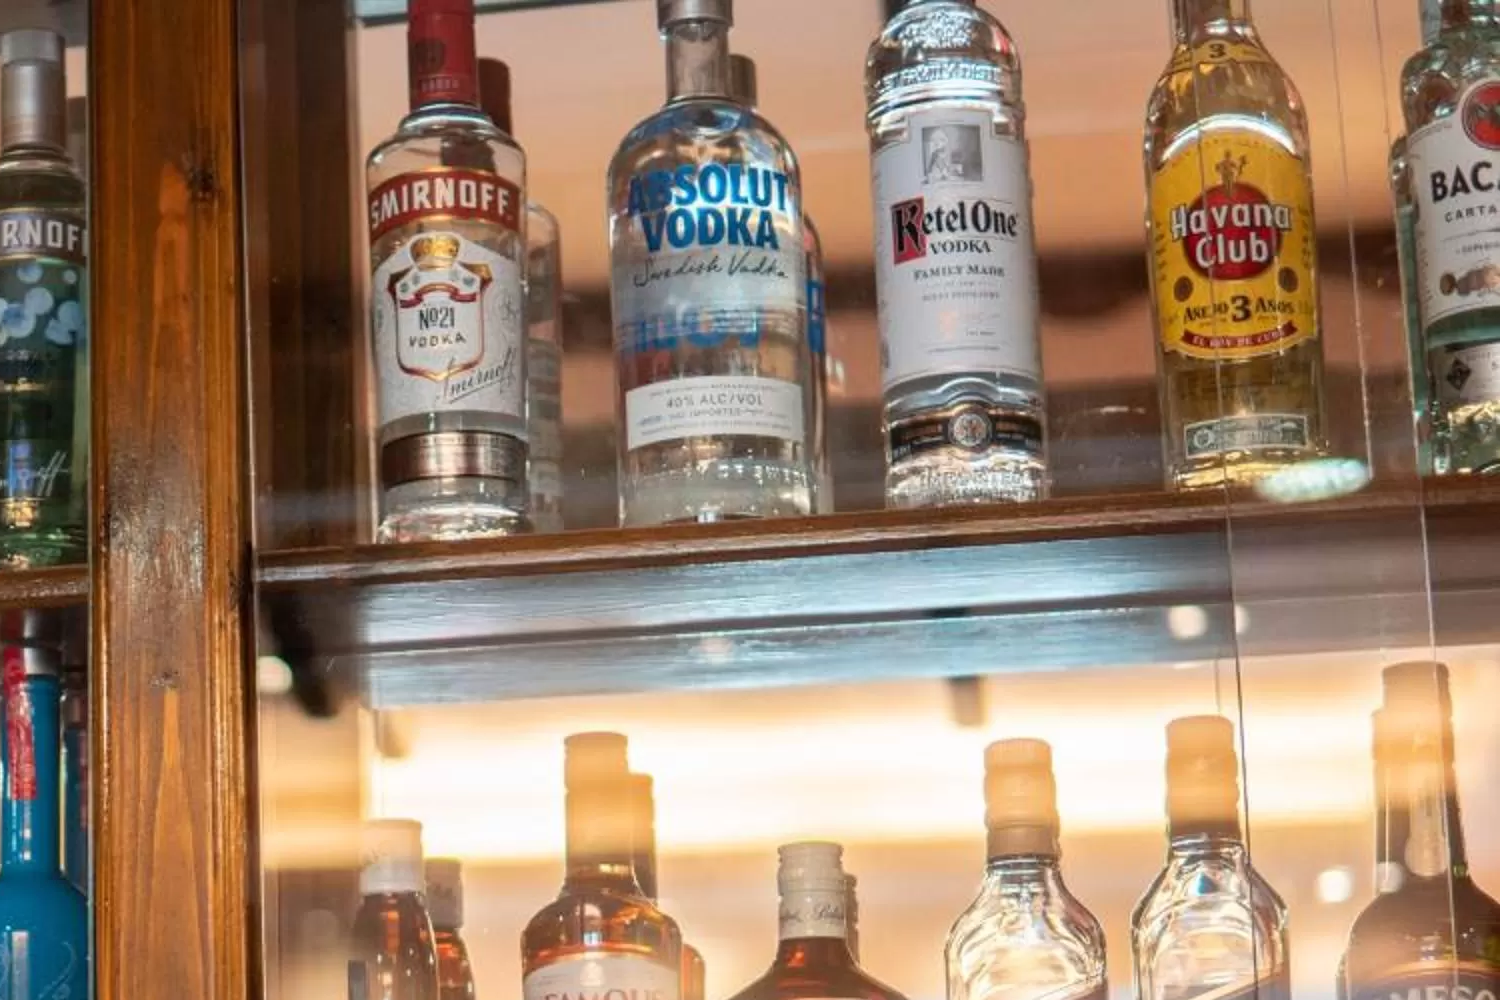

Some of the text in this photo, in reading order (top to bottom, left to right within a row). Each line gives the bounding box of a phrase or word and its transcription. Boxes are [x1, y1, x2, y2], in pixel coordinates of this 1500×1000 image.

[629, 163, 790, 216] ABSOLUT
[1430, 161, 1500, 204] BAC
[372, 177, 510, 229] SMIRNOFF
[1444, 204, 1498, 223] CARTA
[641, 206, 780, 252] VODKA
[894, 200, 1017, 254] Ketel One
[1170, 203, 1293, 243] Havana
[930, 239, 992, 255] VODKA
[1195, 235, 1271, 269] Club
[633, 251, 789, 288] Swedish Vodka
[1231, 295, 1252, 323] 3
[409, 334, 467, 348] VODKA
